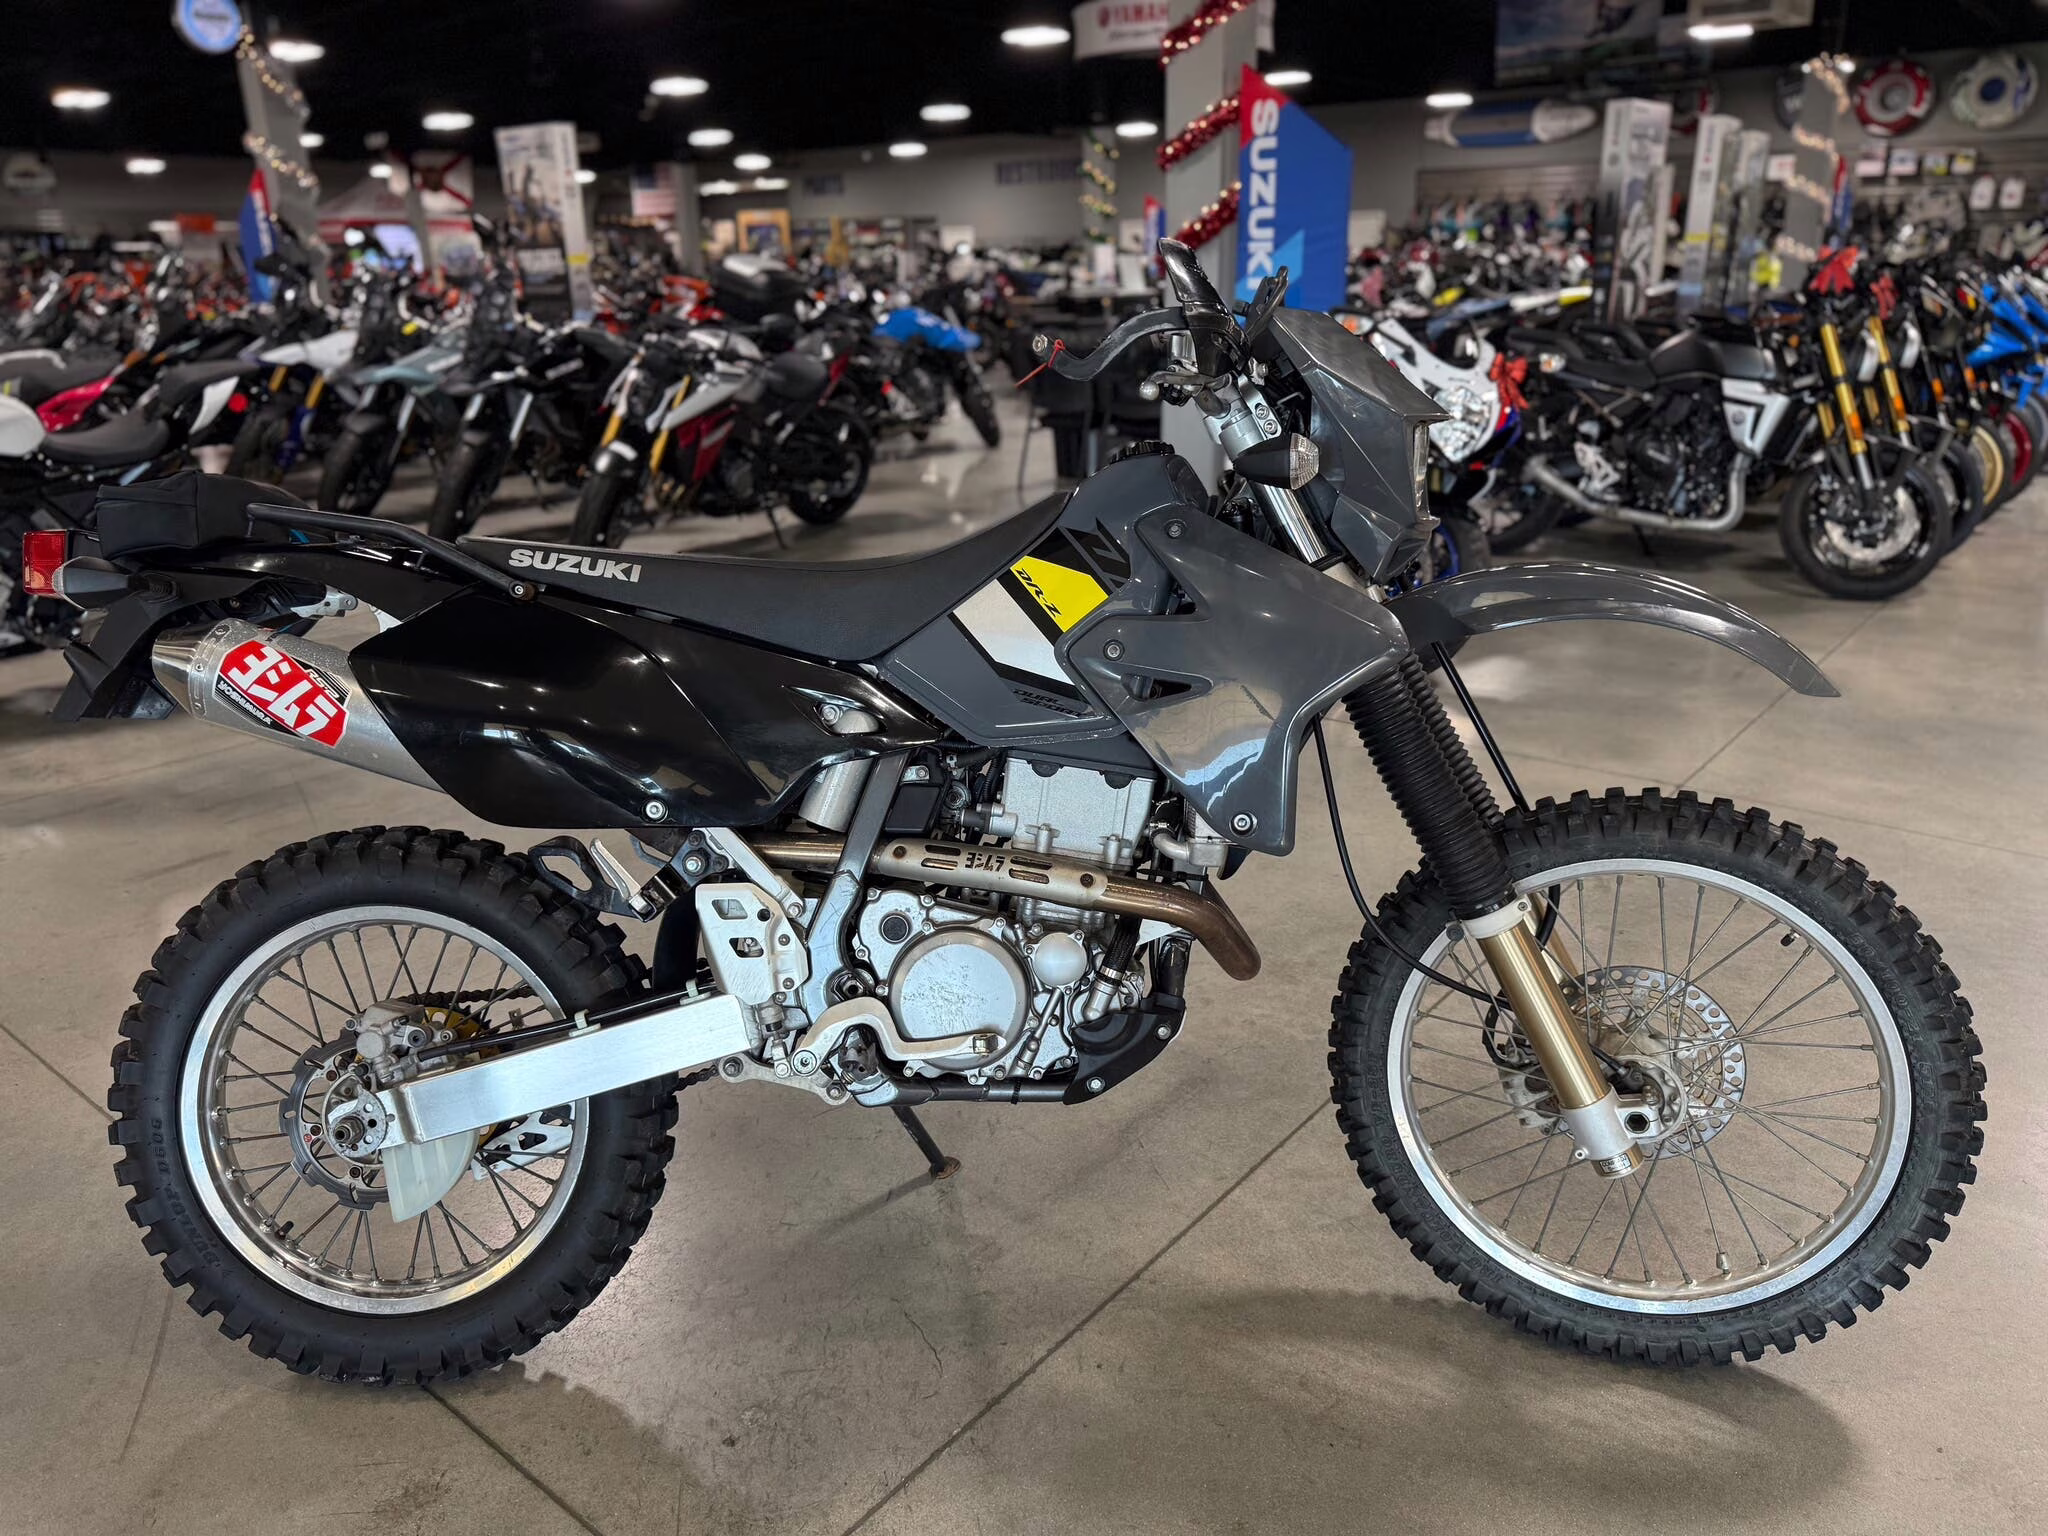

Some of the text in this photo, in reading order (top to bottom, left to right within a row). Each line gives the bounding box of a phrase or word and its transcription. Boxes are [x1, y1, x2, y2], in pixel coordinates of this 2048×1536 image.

[1246, 98, 1281, 291] SUZUKI
[508, 548, 643, 583] SUZUKI
[1015, 567, 1063, 619] DR-Z
[216, 680, 274, 725] YOSHIMURA
[227, 645, 339, 737] ヨシムラ
